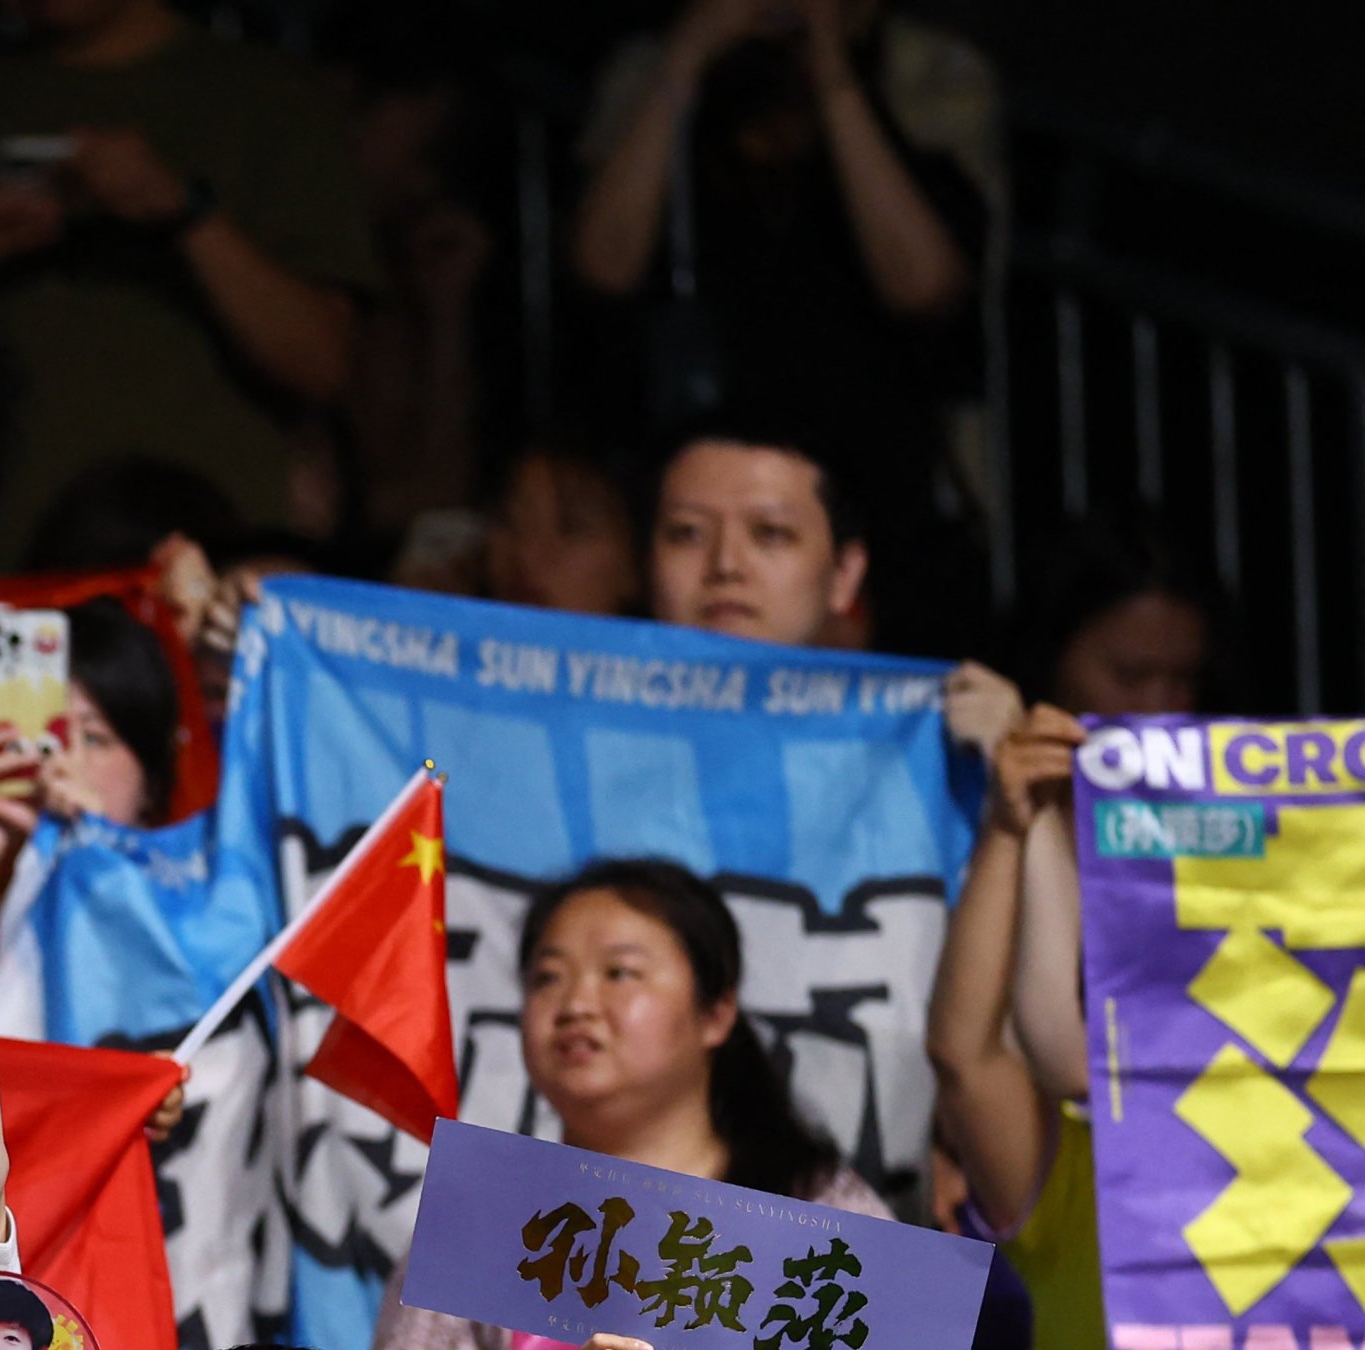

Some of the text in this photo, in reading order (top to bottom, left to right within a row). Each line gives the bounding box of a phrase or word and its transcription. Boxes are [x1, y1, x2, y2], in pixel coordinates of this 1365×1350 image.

[477, 638, 556, 694] SUN
[566, 645, 749, 713] YINGSHA
[763, 667, 845, 714] SUN
[1077, 726, 1206, 791] ON
